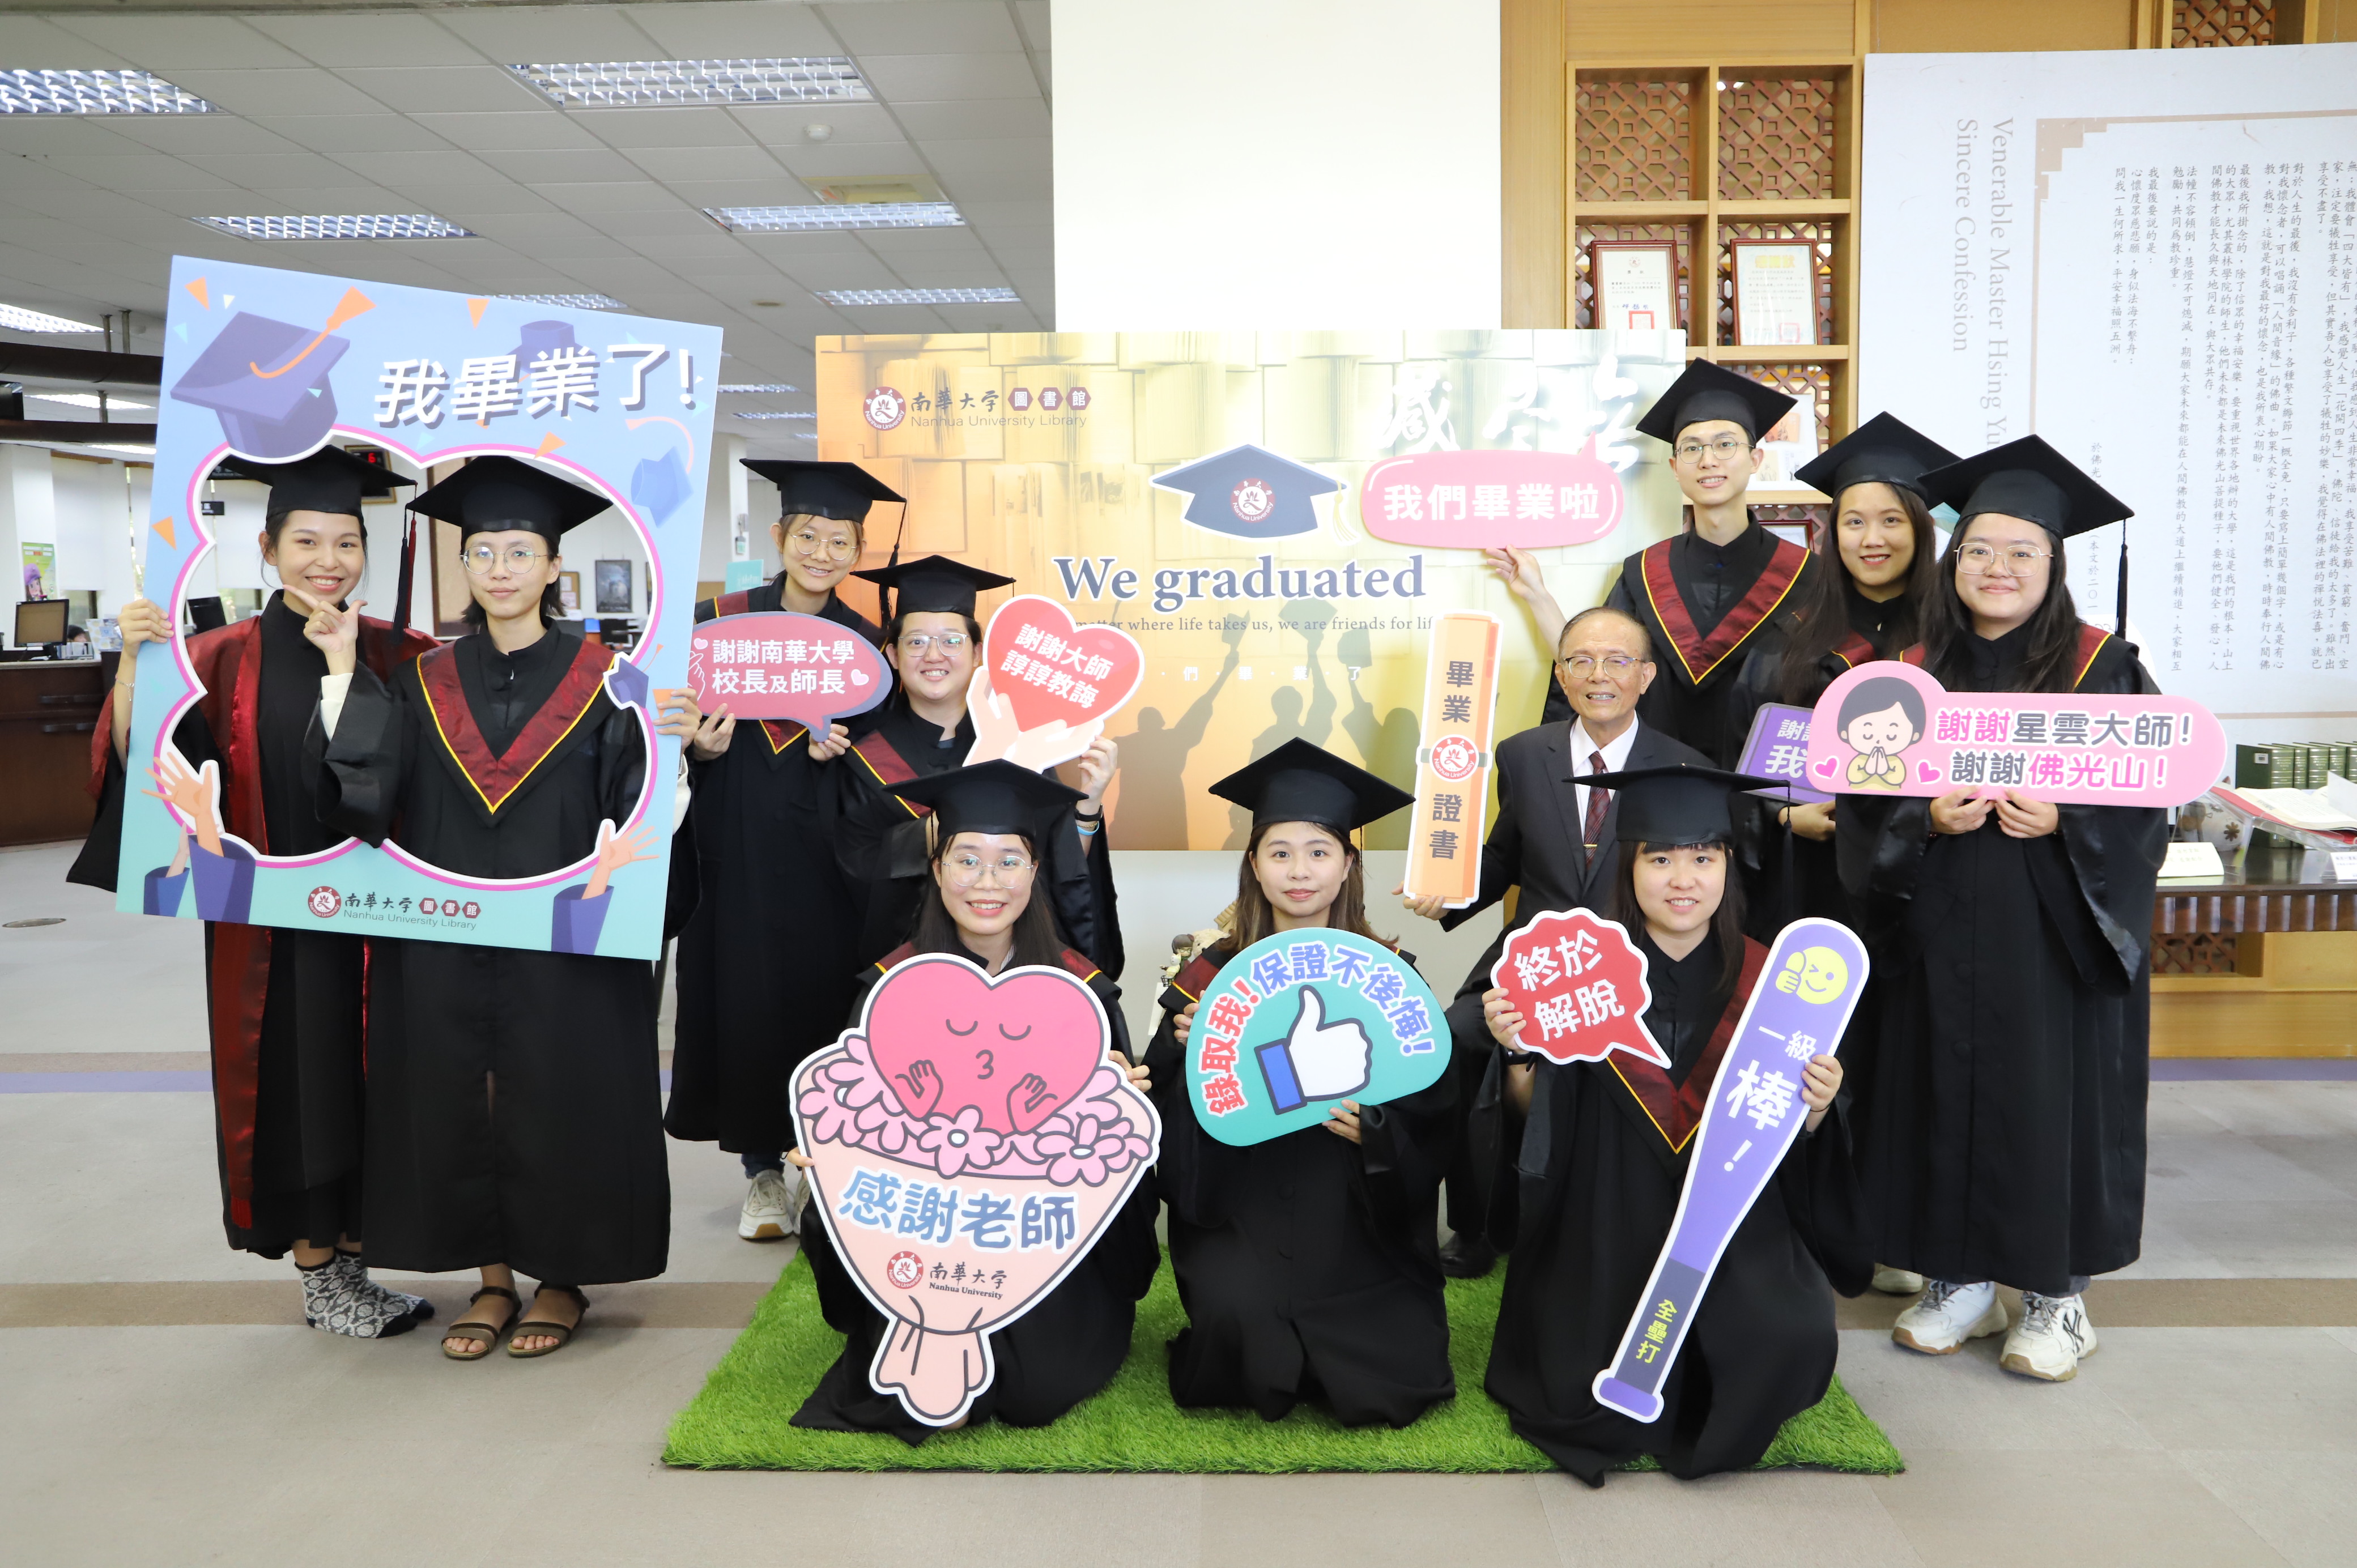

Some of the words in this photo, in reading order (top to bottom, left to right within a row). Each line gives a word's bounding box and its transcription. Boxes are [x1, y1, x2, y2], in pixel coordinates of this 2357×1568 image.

[1956, 118, 1978, 208] Sincere
[1990, 116, 2014, 238] Venerable
[1954, 216, 1976, 351] Confession
[1989, 248, 2010, 330] Master
[373, 344, 691, 424] 我畢業了!
[1014, 391, 1086, 407] 圖書館
[1980, 338, 2009, 409] Hsing
[911, 415, 963, 427] Nanhua
[969, 415, 1035, 429] University
[1040, 414, 1087, 428] Library
[1986, 415, 2008, 451] Yu
[2091, 442, 2103, 485] 於佛光
[1384, 483, 1599, 521] 我們畢業啦
[1054, 558, 1138, 600] We
[1154, 554, 1426, 612] graduated
[712, 640, 854, 664] 謝謝南華大學
[1015, 623, 1114, 681] 謝謝大師
[1129, 617, 1175, 630] where
[1179, 616, 1202, 630] life
[1208, 616, 1246, 630] takes
[1252, 620, 1273, 633] us,
[1278, 621, 1299, 630] we
[1304, 621, 1326, 630] are
[1331, 616, 1385, 630] friends
[1390, 616, 1413, 630] for
[1416, 616, 1433, 630] lif
[712, 668, 845, 694] 校長及師長
[1000, 649, 1099, 709] 諄諄教誨
[1441, 661, 1474, 724] 畢業
[1937, 710, 2190, 747] 謝謝星雲大師!
[1951, 751, 2165, 788] 謝謝佛光山!
[1429, 793, 1463, 860] 證書
[343, 910, 384, 921] Nanhua
[388, 913, 438, 927] University
[441, 918, 476, 931] Library
[423, 900, 478, 916] 圖書館
[1514, 929, 1603, 992] 終於
[1253, 943, 1433, 1054] 保證不後悔!
[1534, 978, 1625, 1042] 解脫
[1758, 1026, 1816, 1063] 一級
[839, 1170, 1075, 1249] 感謝老師
[929, 1282, 959, 1293] Nanhua
[961, 1286, 1003, 1300] University
[1636, 1299, 1678, 1364] 全壘打
